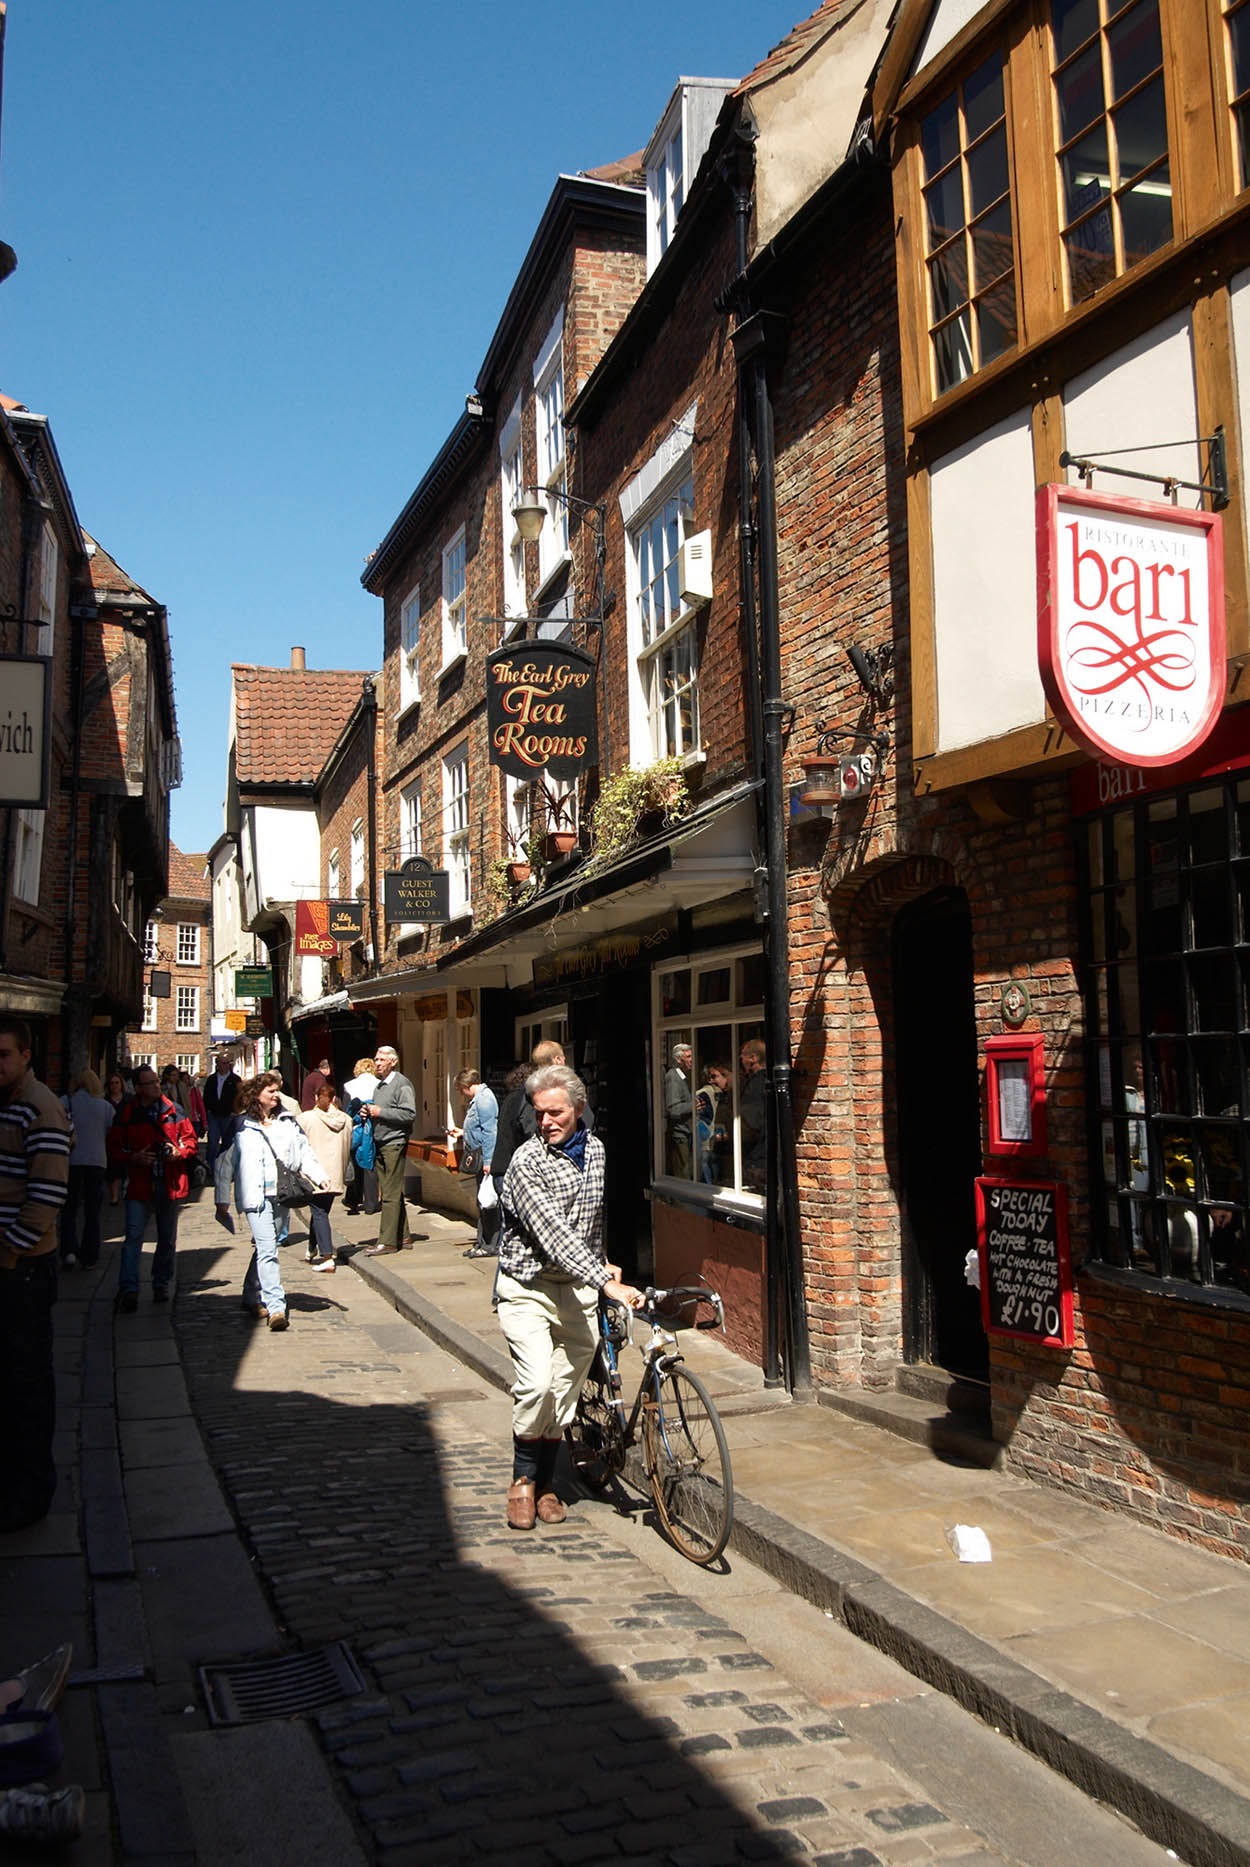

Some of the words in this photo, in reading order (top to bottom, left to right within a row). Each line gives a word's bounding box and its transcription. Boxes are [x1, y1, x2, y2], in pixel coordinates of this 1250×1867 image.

[1085, 526, 1190, 558] RISTORANTE
[1065, 521, 1199, 626] bari
[491, 661, 520, 684] The
[520, 663, 553, 683] Earl
[553, 665, 590, 690] Grey
[502, 685, 568, 726] Tea
[1079, 697, 1191, 724] PIZZERIA
[493, 722, 588, 768] Rooms
[397, 890, 438, 898] WALKER
[401, 880, 433, 888] GUEST
[415, 899, 431, 908] CO
[299, 937, 334, 952] Images
[990, 1188, 1053, 1213] SPECIAL
[1000, 1210, 1048, 1232] TODAY
[1007, 1254, 1058, 1275] CHOCOLATE
[1015, 1269, 1023, 1282] A
[1026, 1271, 1058, 1289] FRESH
